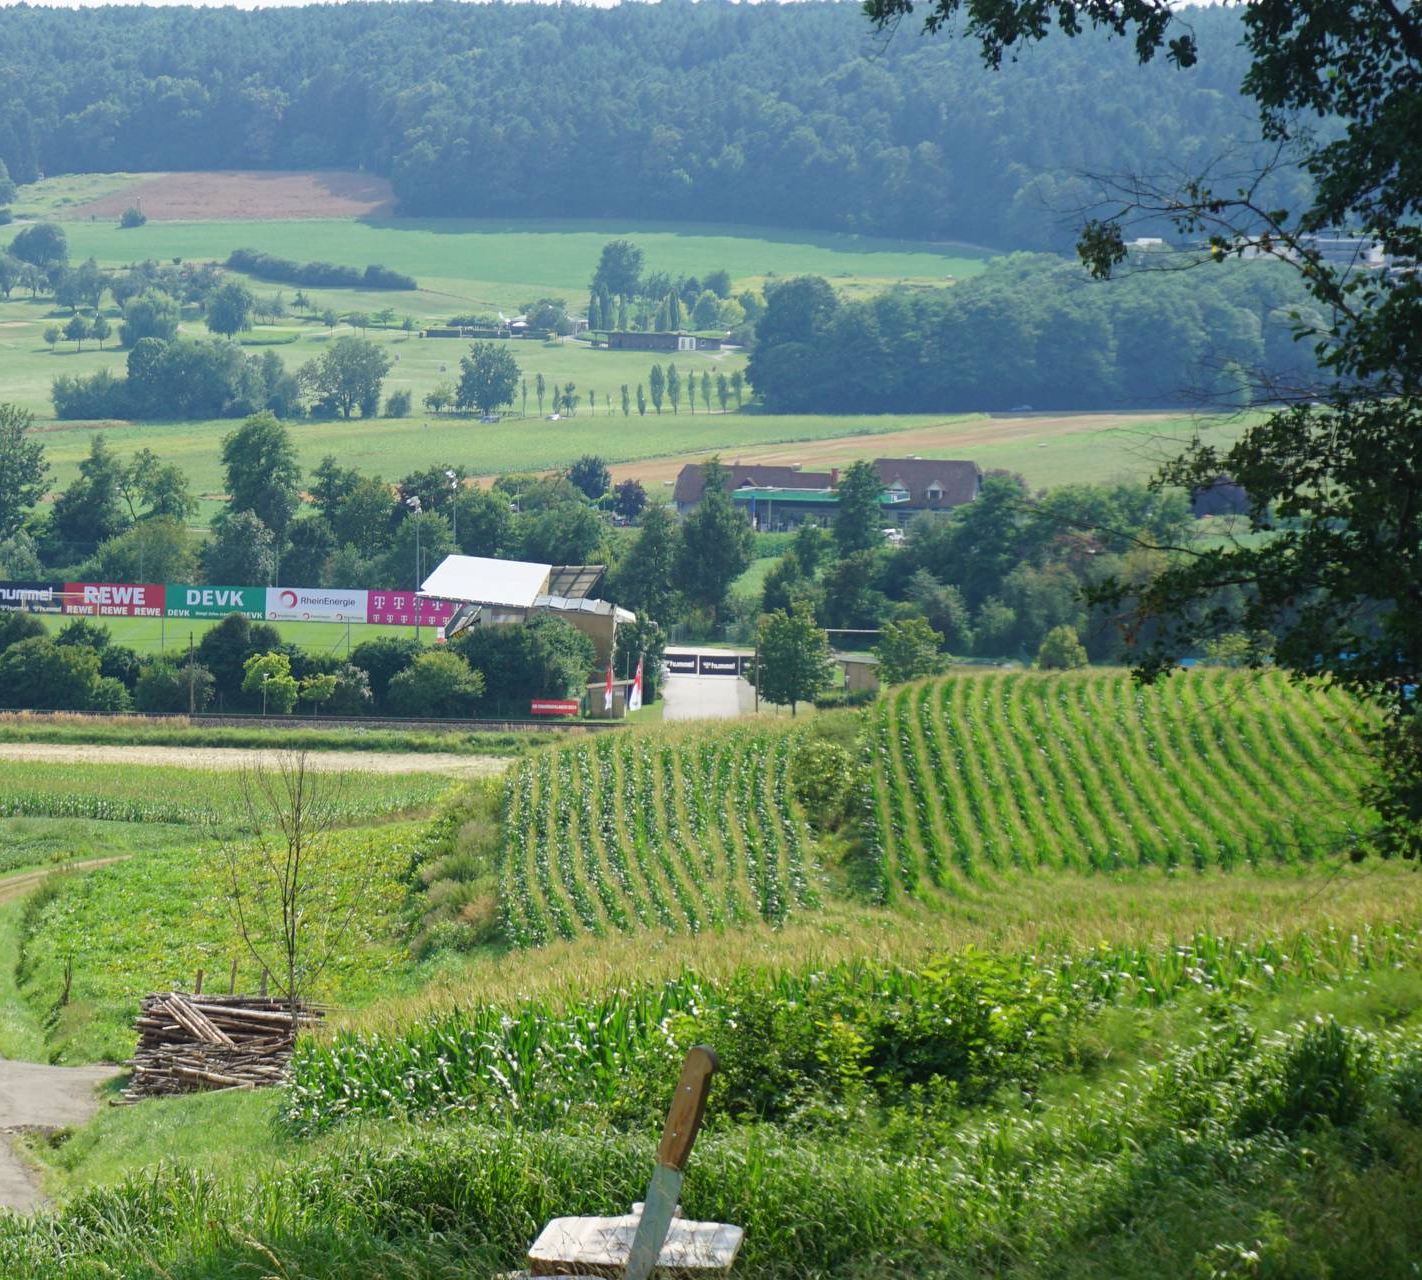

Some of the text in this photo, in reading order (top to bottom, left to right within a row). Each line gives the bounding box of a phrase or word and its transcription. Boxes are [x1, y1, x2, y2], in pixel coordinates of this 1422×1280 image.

[84, 586, 145, 605] REWE
[186, 590, 244, 607] DEVK
[300, 597, 356, 607] RheinEnergie
[67, 606, 161, 616] REWE REWE REWE
[168, 609, 190, 617] DEVK
